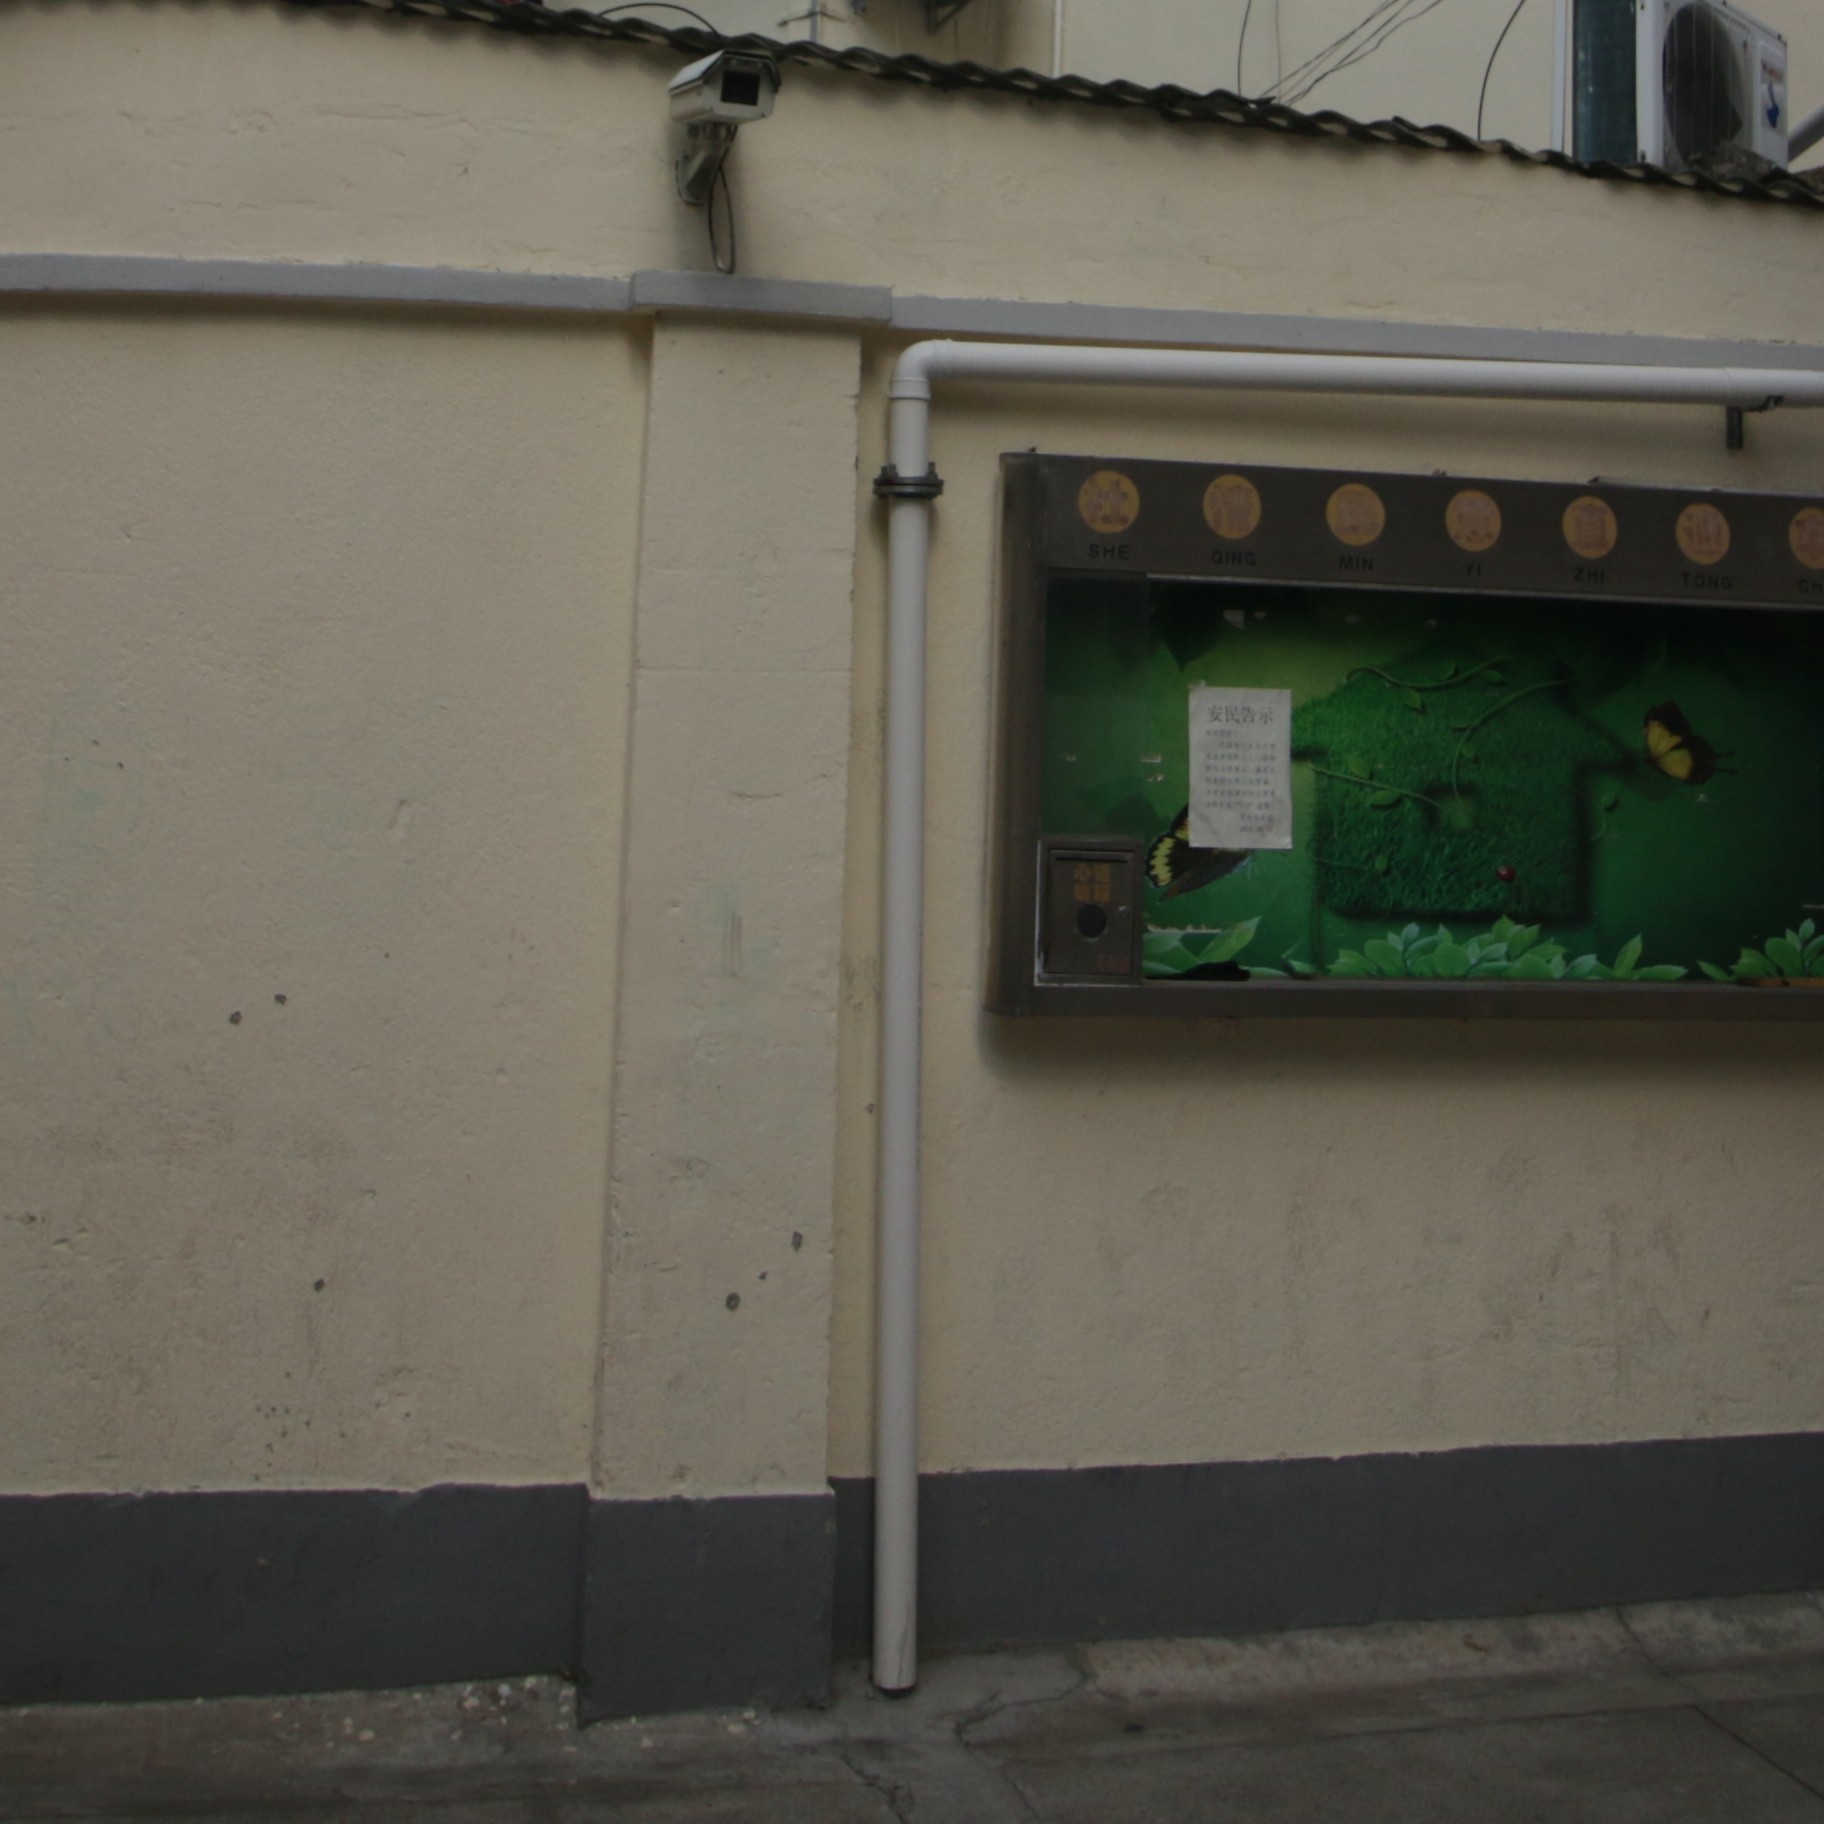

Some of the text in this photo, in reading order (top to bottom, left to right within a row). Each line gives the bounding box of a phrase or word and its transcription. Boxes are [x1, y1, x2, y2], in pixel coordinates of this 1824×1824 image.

[1088, 543, 1130, 561] SHE
[1210, 549, 1257, 567] QING
[1338, 555, 1375, 572] MIN
[1463, 561, 1483, 577] YI
[1573, 567, 1606, 584] ZHI
[1681, 572, 1734, 591] TONG
[1207, 704, 1274, 725] 安民告示
